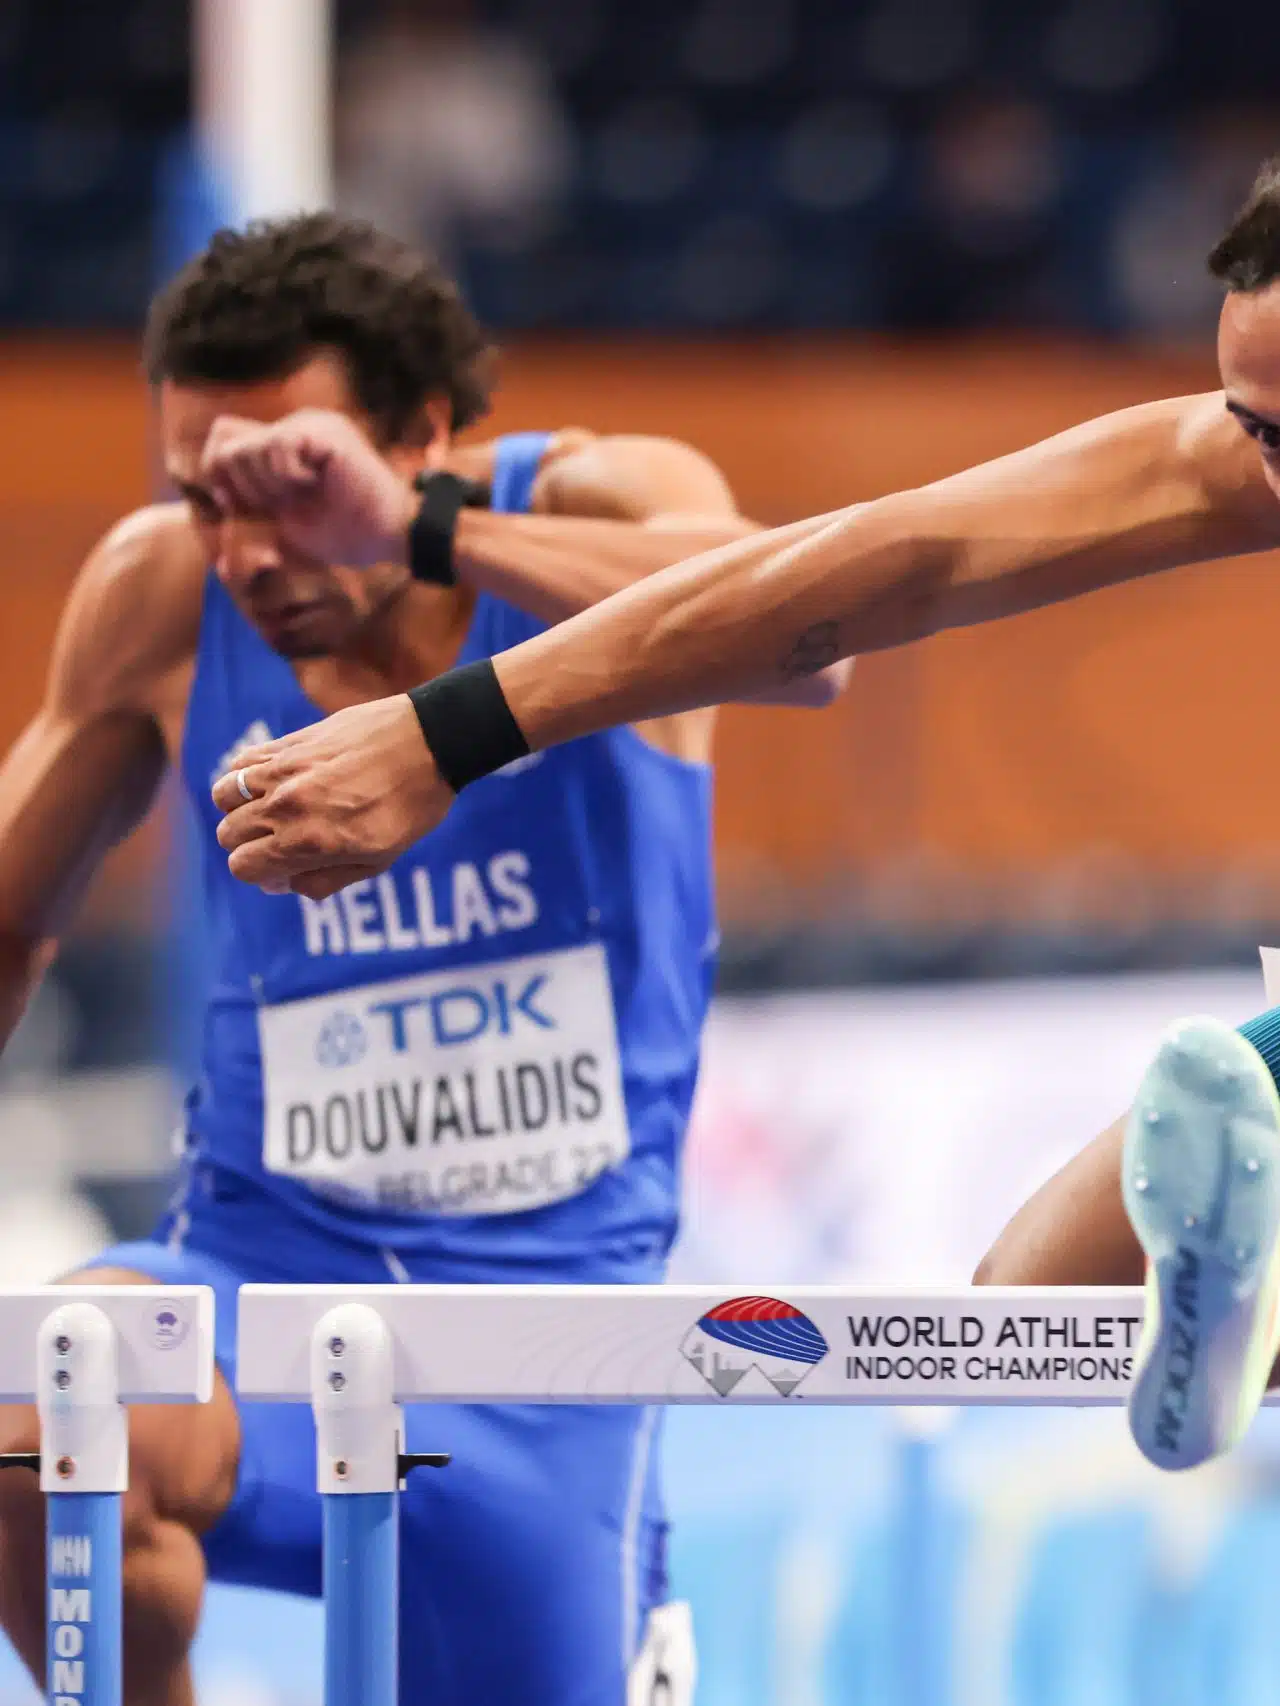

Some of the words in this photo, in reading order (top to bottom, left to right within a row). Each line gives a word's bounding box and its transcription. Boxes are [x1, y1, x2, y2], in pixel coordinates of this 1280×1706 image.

[298, 849, 540, 957] HELLAS
[367, 973, 557, 1056] TDK
[285, 1052, 604, 1167] DOUVALIDIS
[845, 1356, 957, 1380] INDOOR
[964, 1356, 1134, 1380] CHAMPIONS
[846, 1315, 984, 1348] WORLD
[995, 1315, 1140, 1348] ATHLET
